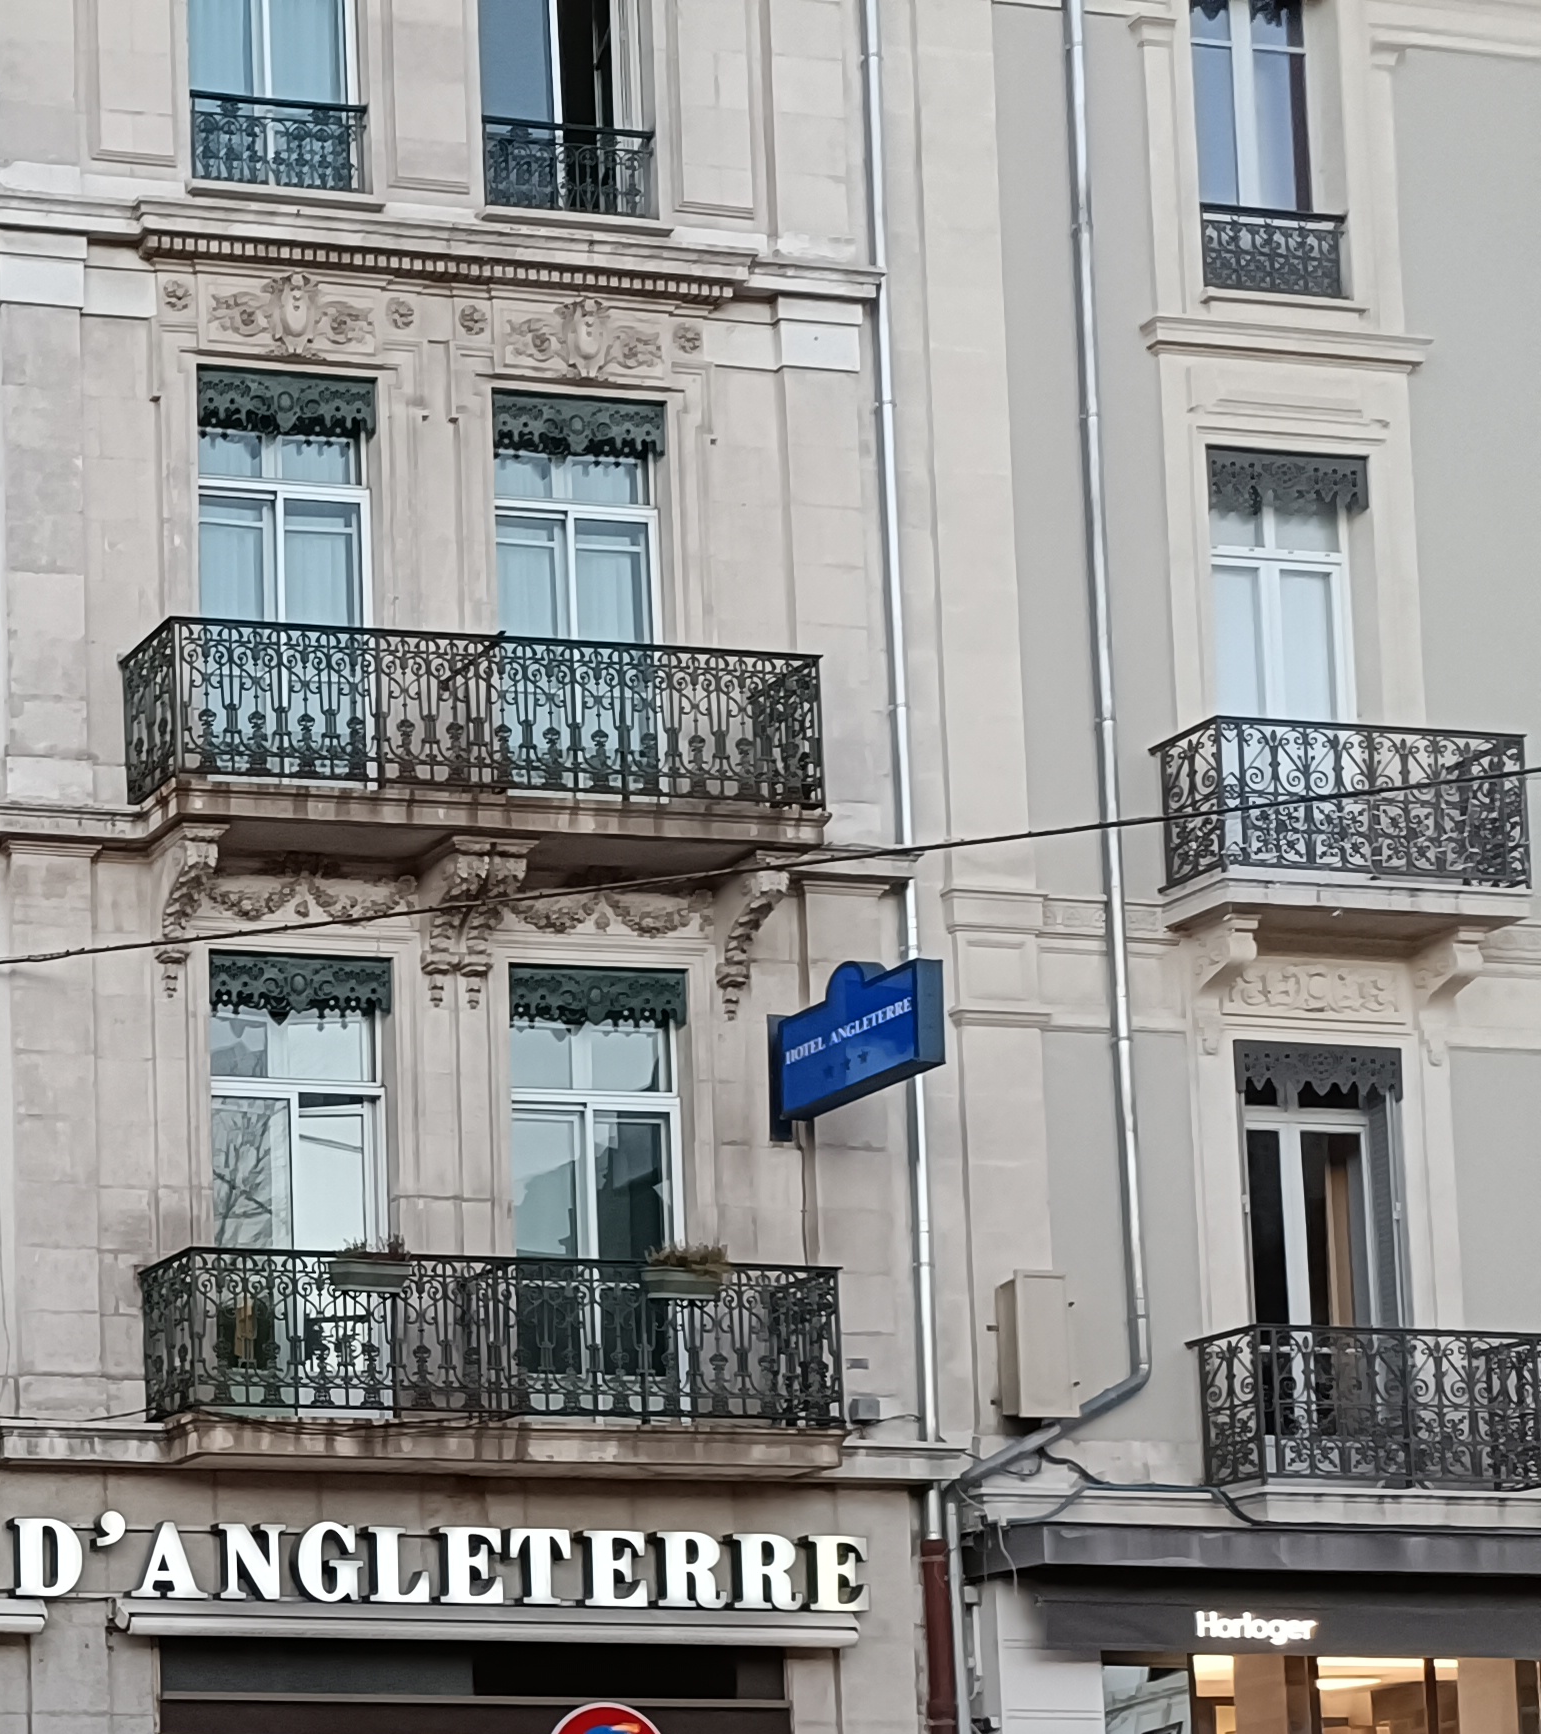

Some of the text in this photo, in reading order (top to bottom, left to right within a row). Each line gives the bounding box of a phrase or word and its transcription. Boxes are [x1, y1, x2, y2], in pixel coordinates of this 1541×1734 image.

[784, 997, 912, 1066] HOTEL ANGLETERRE
[13, 1509, 870, 1611] D'ANGLETERRE
[1195, 1610, 1318, 1646] Horloger
